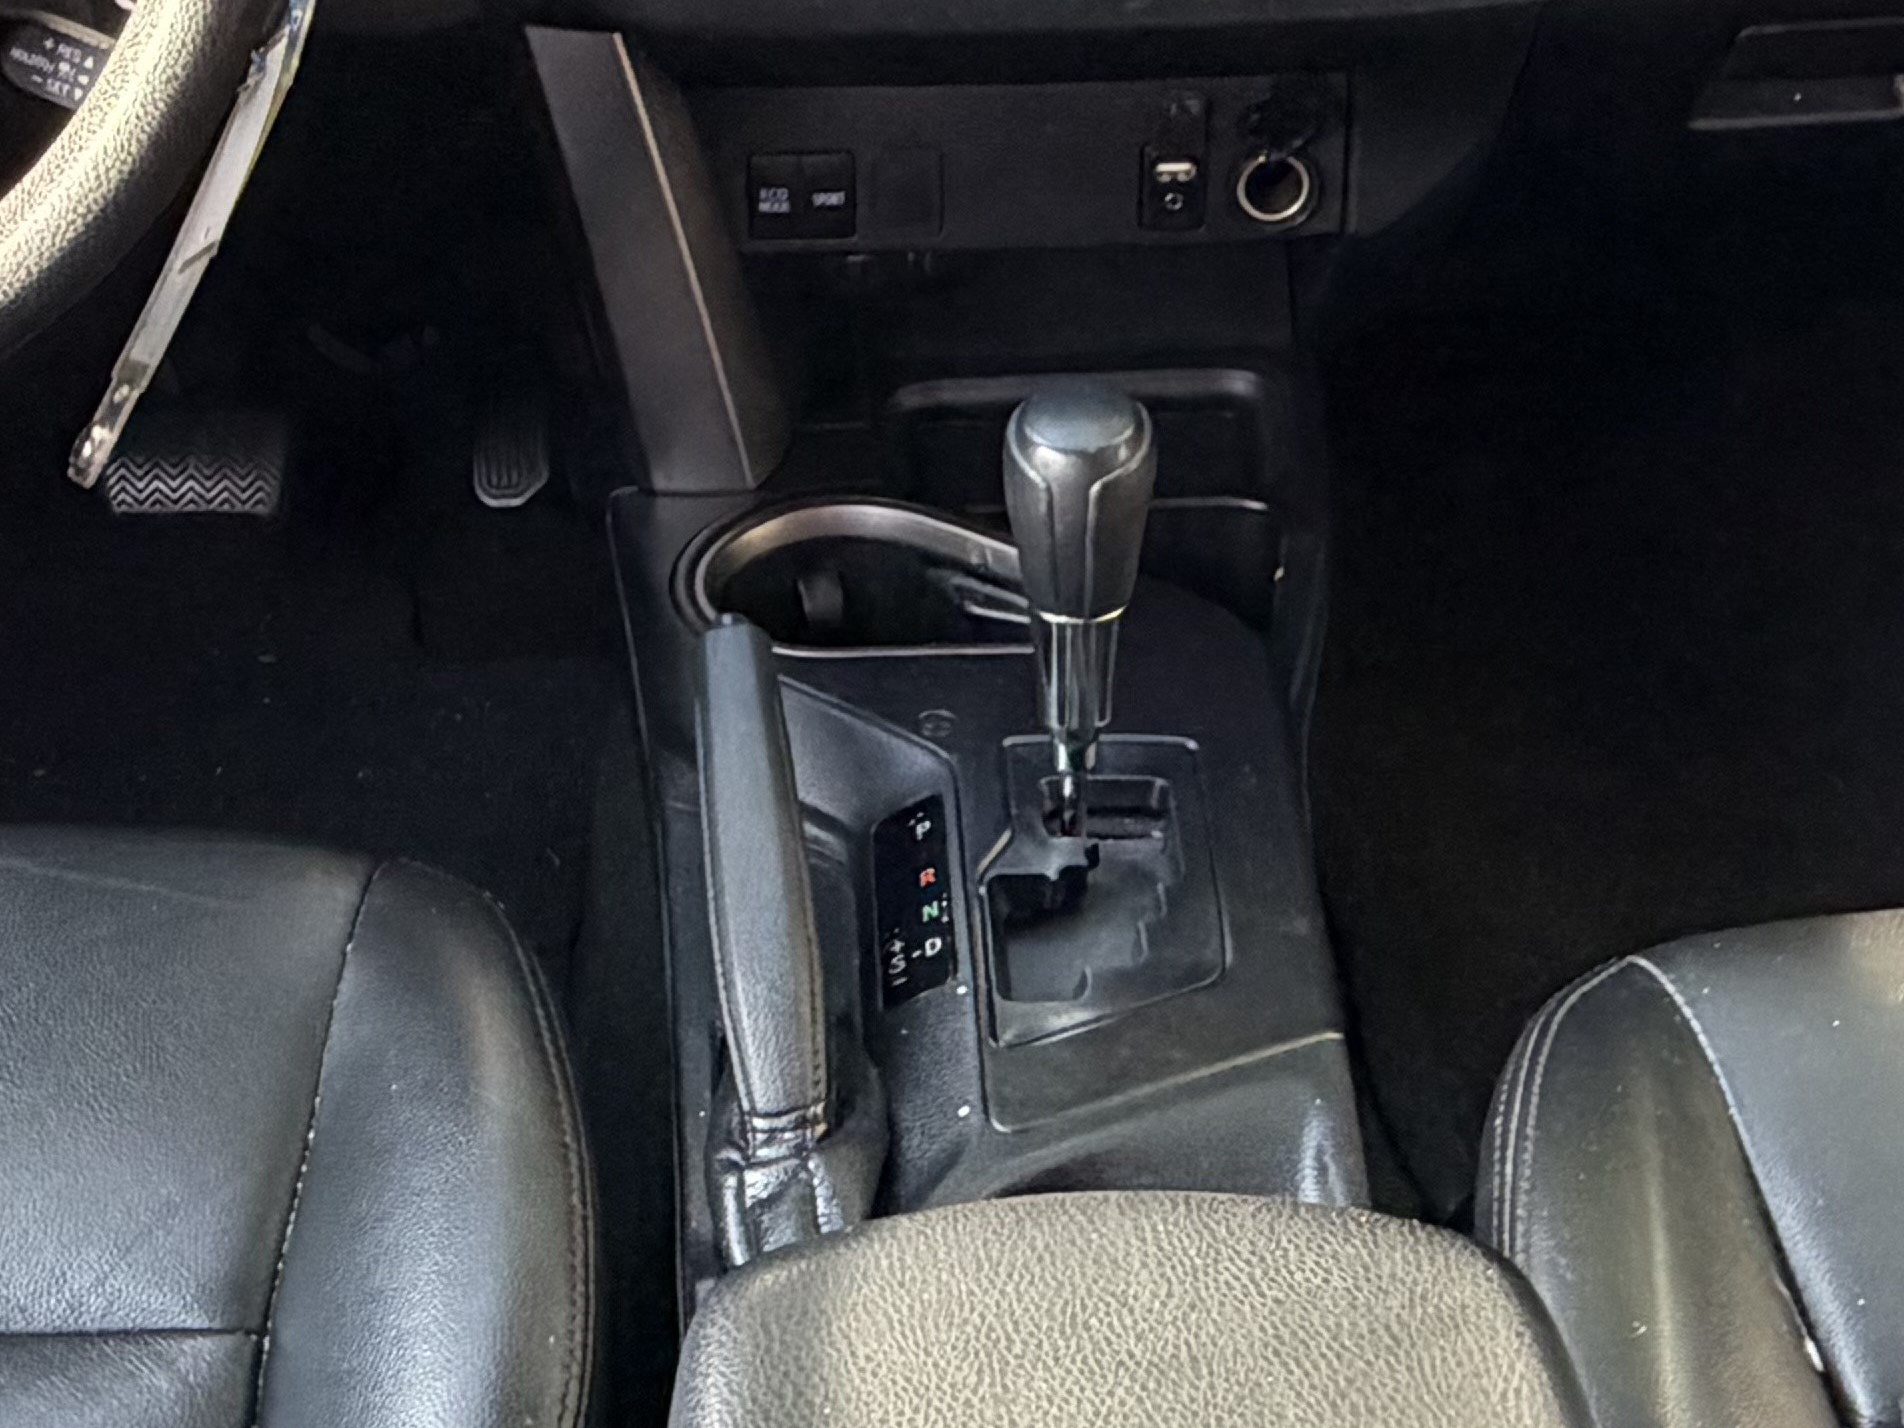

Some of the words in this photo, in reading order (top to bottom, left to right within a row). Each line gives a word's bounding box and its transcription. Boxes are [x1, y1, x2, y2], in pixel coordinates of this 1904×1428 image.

[916, 821, 932, 841] P
[919, 867, 937, 888] R
[922, 900, 940, 923] N
[925, 937, 943, 958] D
[888, 953, 908, 974] S
